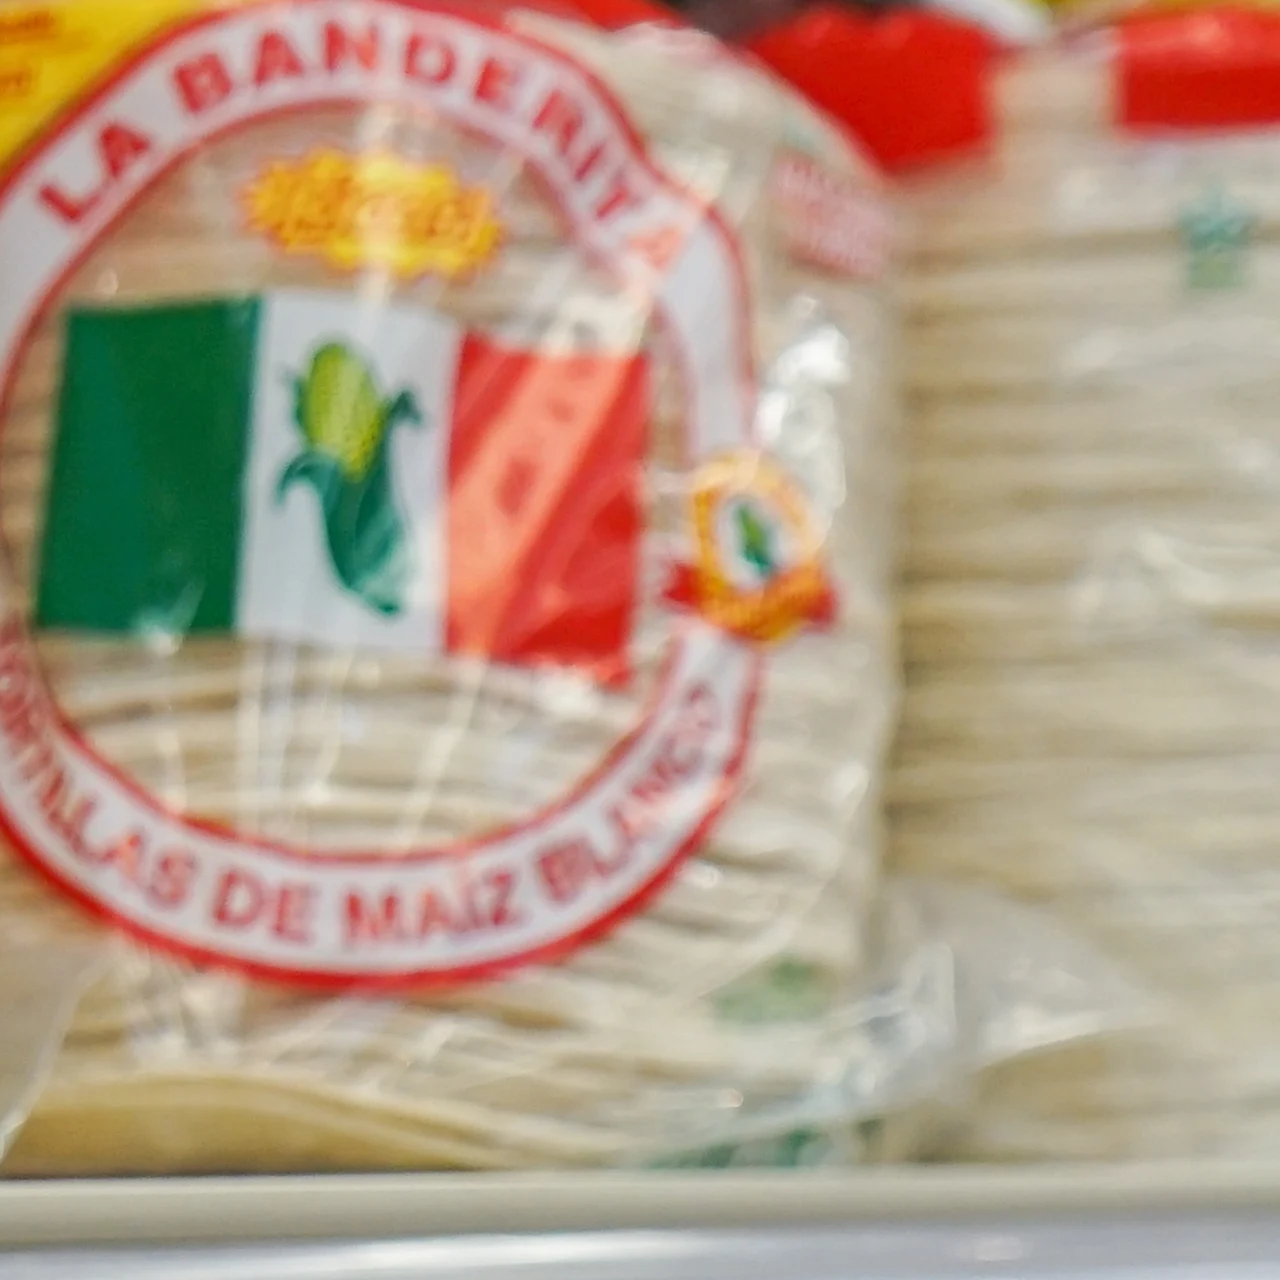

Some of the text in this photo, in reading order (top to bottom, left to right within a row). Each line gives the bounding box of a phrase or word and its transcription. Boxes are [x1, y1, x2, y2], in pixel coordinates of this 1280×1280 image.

[39, 120, 153, 225] LA
[171, 19, 683, 270] BANDERITA
[214, 869, 321, 943] DE
